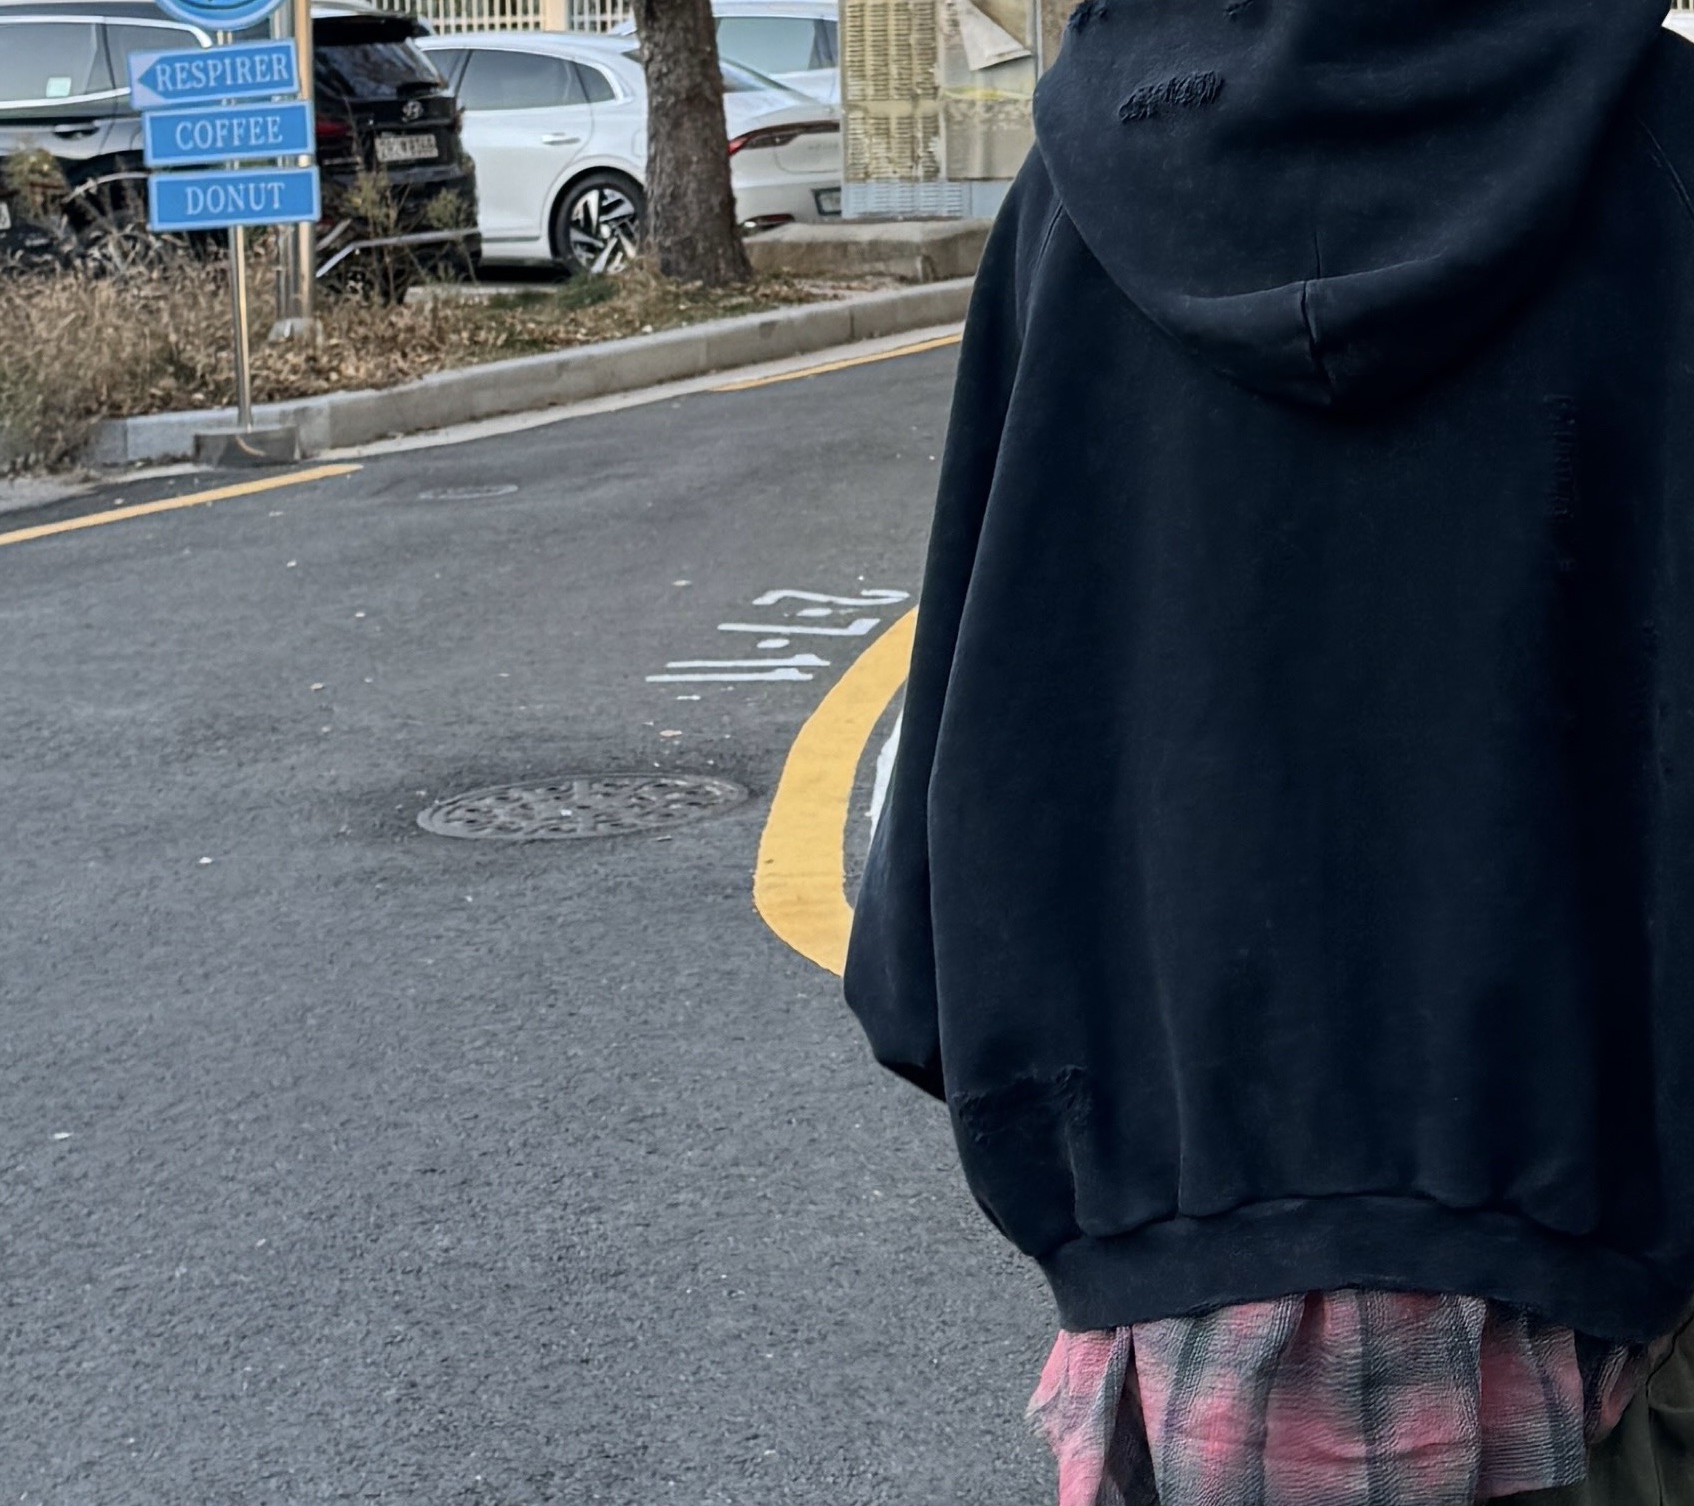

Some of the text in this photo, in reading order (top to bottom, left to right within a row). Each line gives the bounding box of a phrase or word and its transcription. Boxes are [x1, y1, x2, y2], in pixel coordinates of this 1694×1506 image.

[156, 53, 290, 92] RESPIRER
[175, 116, 284, 150] COFFEE
[185, 182, 285, 215] DONUT
